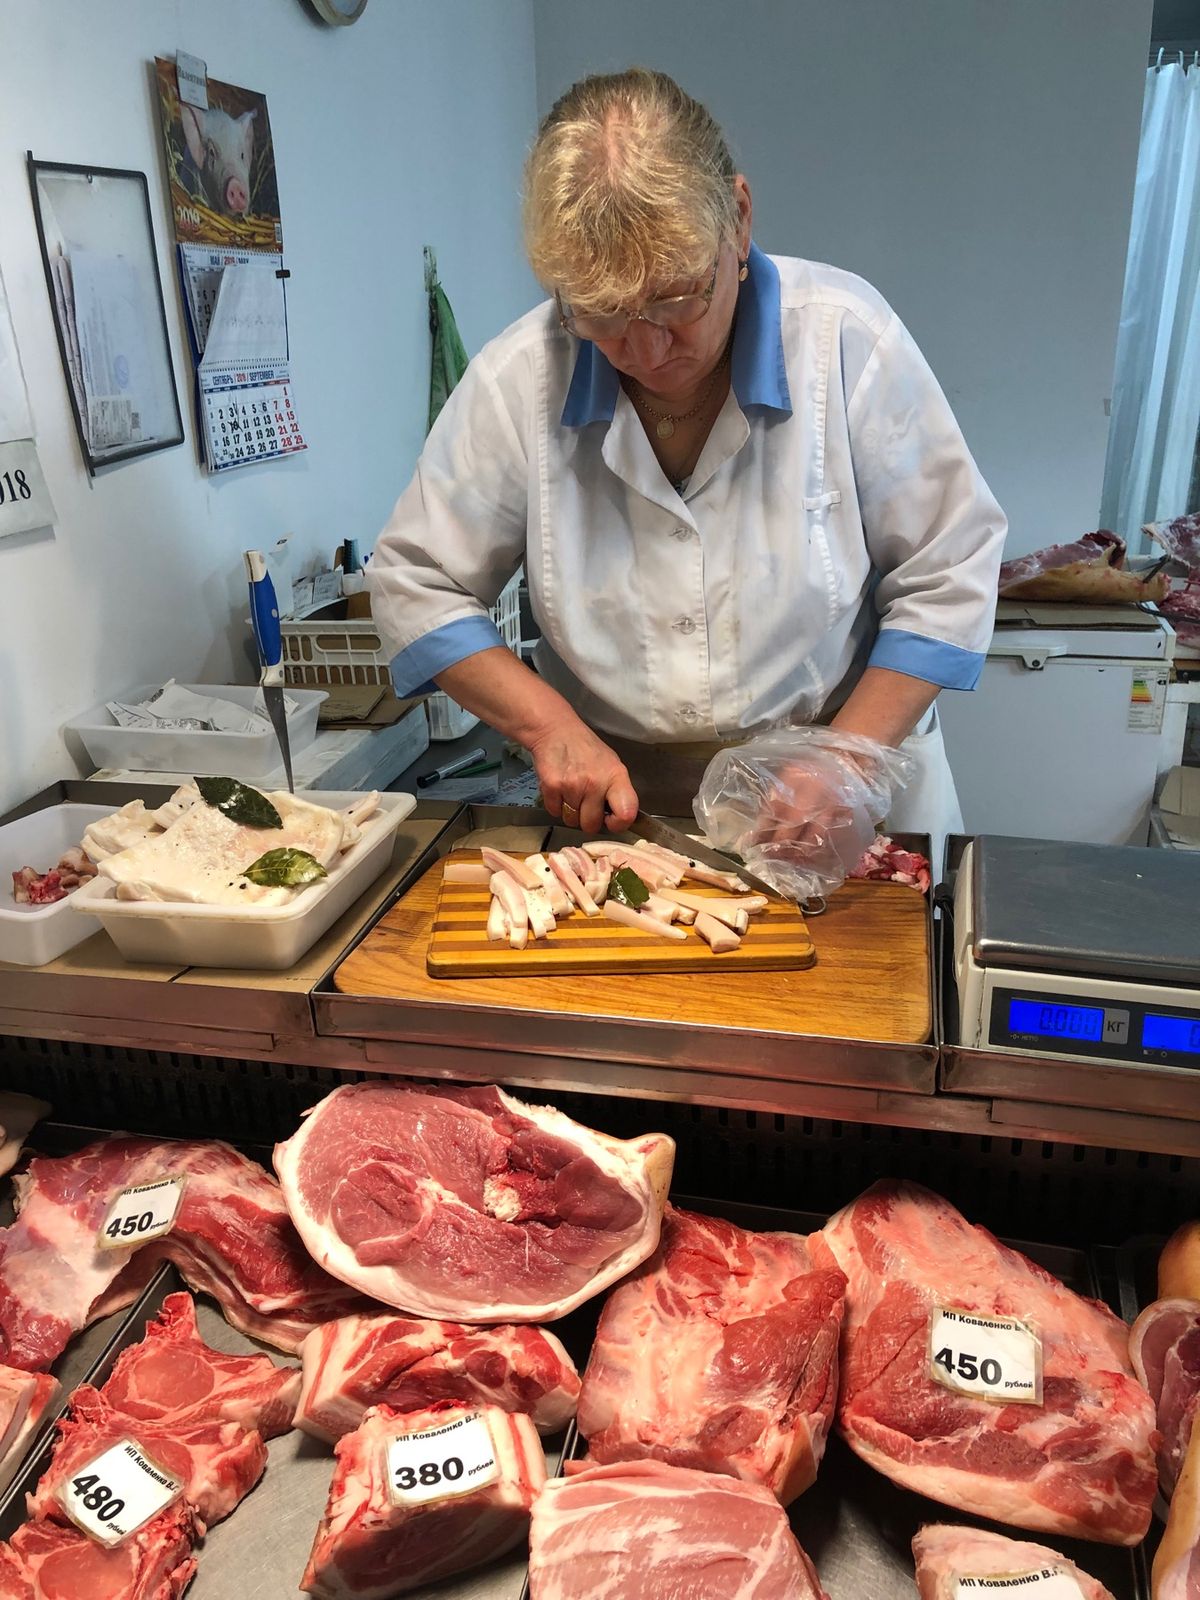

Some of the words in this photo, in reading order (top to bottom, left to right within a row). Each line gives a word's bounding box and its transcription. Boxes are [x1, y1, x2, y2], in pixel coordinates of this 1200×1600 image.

[249, 370, 274, 381] SEPTEMBER
[284, 386, 287, 395] 1
[219, 409, 223, 419] 2
[229, 407, 234, 417] 3
[242, 406, 246, 415] 4
[252, 404, 257, 413] 5
[262, 402, 267, 412] 6
[273, 400, 278, 410] 7
[285, 399, 290, 408] 8
[221, 423, 226, 433] 9
[243, 419, 249, 429] 11
[253, 417, 260, 427] 12
[263, 415, 271, 425] 13
[275, 413, 284, 423] 14
[287, 411, 295, 420] 15
[222, 436, 230, 447] 16
[233, 434, 240, 444] 17
[244, 432, 252, 442] 18
[256, 430, 263, 440] 19
[265, 427, 275, 438] 20
[278, 425, 288, 435] 21
[290, 423, 299, 432] 22
[235, 447, 244, 457] 24
[246, 445, 255, 455] 25
[258, 442, 266, 452] 26
[269, 440, 278, 450] 27
[281, 437, 292, 447] 28
[294, 435, 303, 444] 29
[106, 1211, 154, 1238] 450
[942, 1310, 956, 1320] ИП
[959, 1315, 1012, 1330] Коваленко
[934, 1347, 1002, 1385] 450
[1005, 1380, 1033, 1388] рублей
[394, 1434, 410, 1442] ИП
[412, 1420, 463, 1440] Коваленко
[464, 1412, 483, 1423] В.Г.
[124, 1445, 138, 1458] ИП
[134, 1455, 168, 1485] Коваленко
[395, 1457, 464, 1490] 380
[468, 1458, 494, 1476] рублей
[72, 1474, 125, 1522] 480
[958, 1577, 976, 1587] ИП
[979, 1573, 1040, 1588] Коваленко
